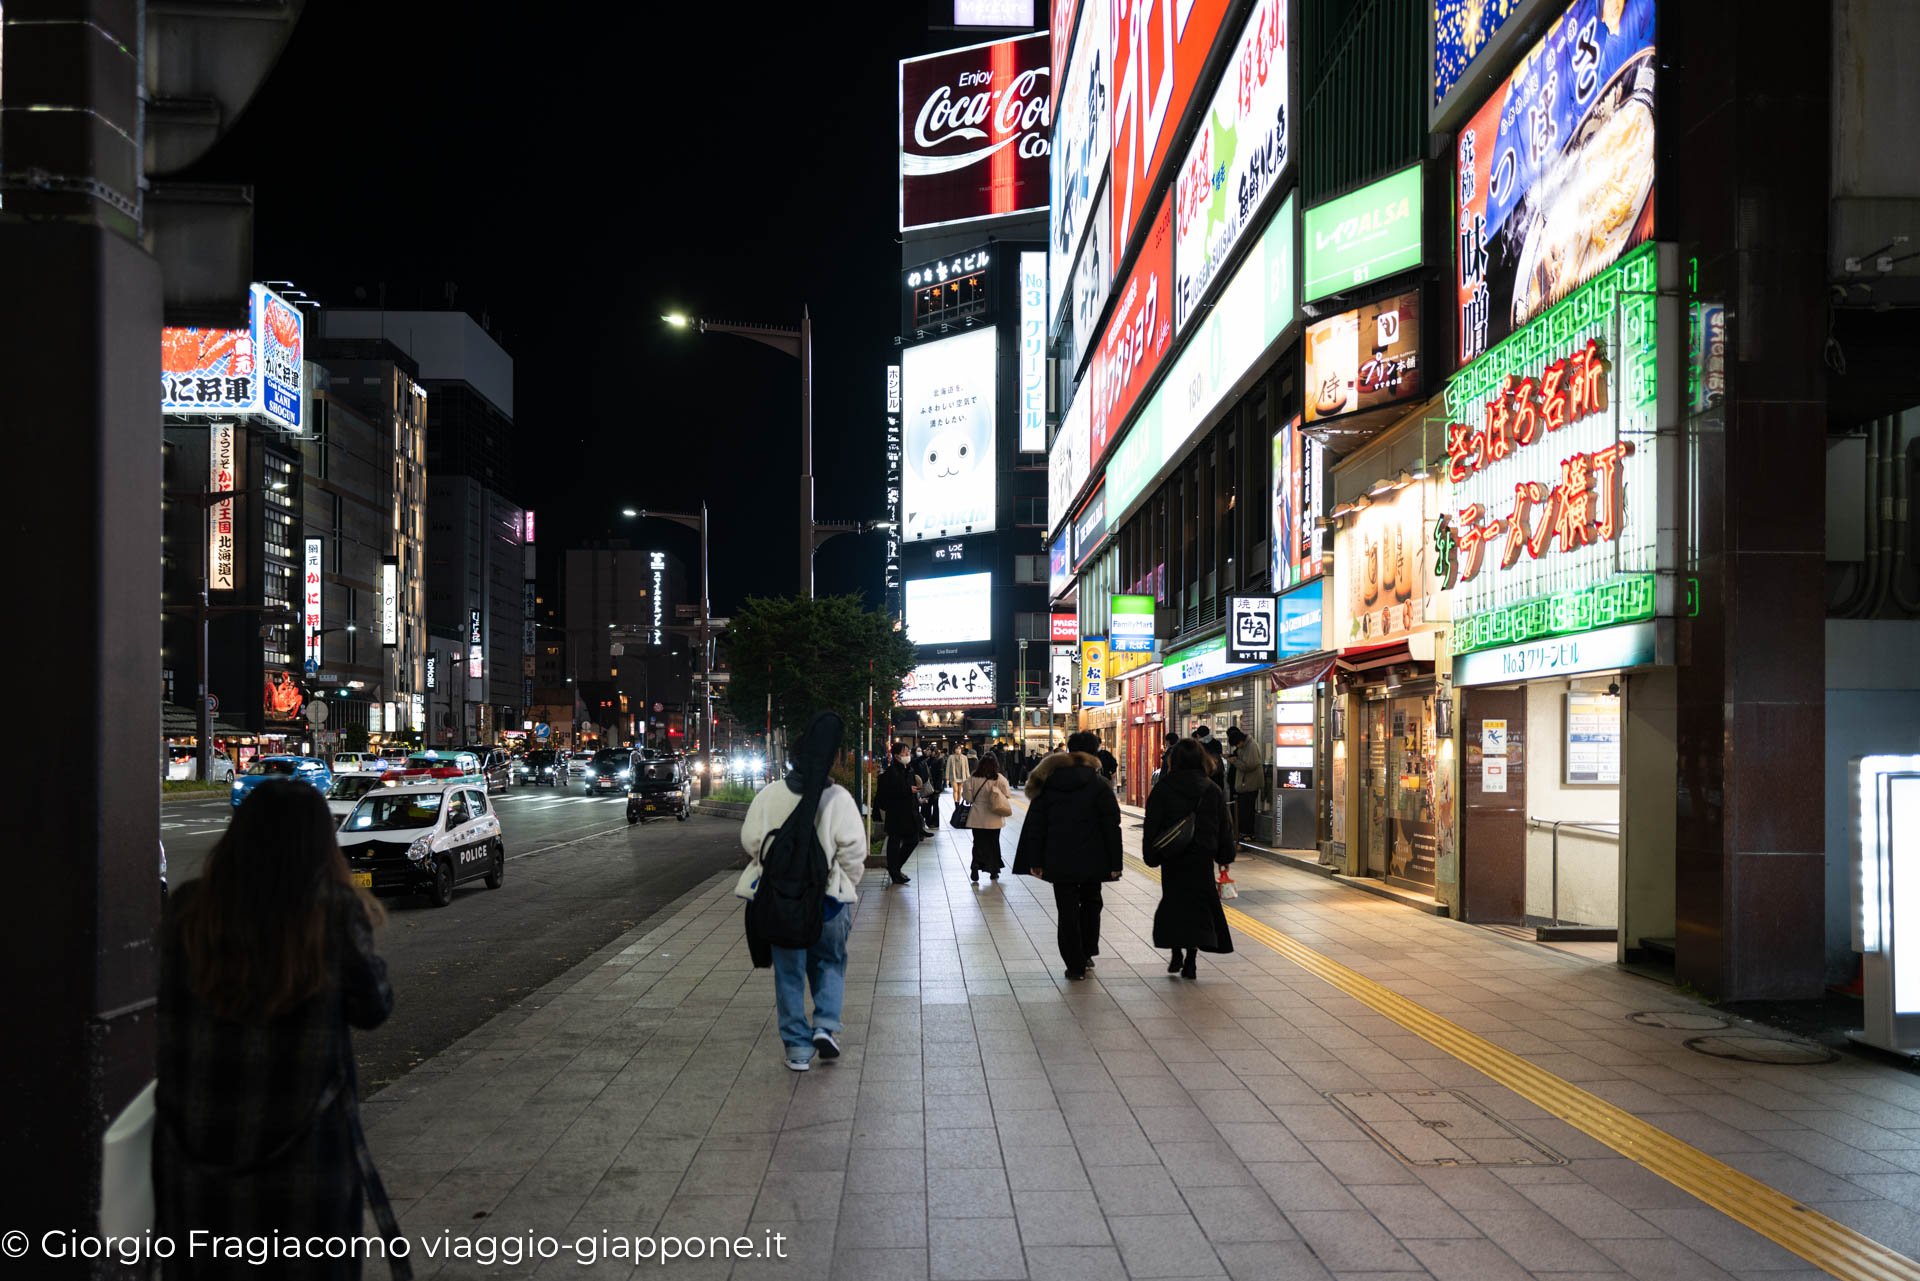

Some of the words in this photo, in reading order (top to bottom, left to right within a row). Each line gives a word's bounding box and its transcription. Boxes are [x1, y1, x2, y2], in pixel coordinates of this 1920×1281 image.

[959, 70, 994, 87] Enjoy
[1018, 132, 1050, 159] Co
[1237, 103, 1287, 228] 魚鮮水産
[1177, 127, 1210, 246] 北海道
[1460, 130, 1488, 361] 究極の味噌
[1178, 273, 1191, 327] 1F
[1190, 213, 1237, 306] UOSEN-SUISAN
[1353, 265, 1370, 284] B1
[1106, 271, 1158, 415] ワタショウ
[1025, 320, 1043, 429] グリーンビル
[1361, 351, 1416, 385] プリン本舗
[274, 390, 291, 408] KANI
[888, 369, 899, 409] ホシビル
[1318, 371, 1340, 403] 侍
[269, 401, 296, 423] SHOGUN
[1450, 338, 1604, 484] さっぽろ名所
[1460, 440, 1626, 582] ラーメン横丁
[1237, 598, 1270, 609] 焼肉
[1112, 620, 1153, 629] FamilyMart
[1241, 618, 1267, 639] 牛角
[1116, 640, 1126, 650] 酒
[1128, 641, 1151, 650] たばこ
[1054, 674, 1070, 703] 松のや
[1086, 666, 1101, 696] 松屋
[460, 844, 488, 864] POLICE
